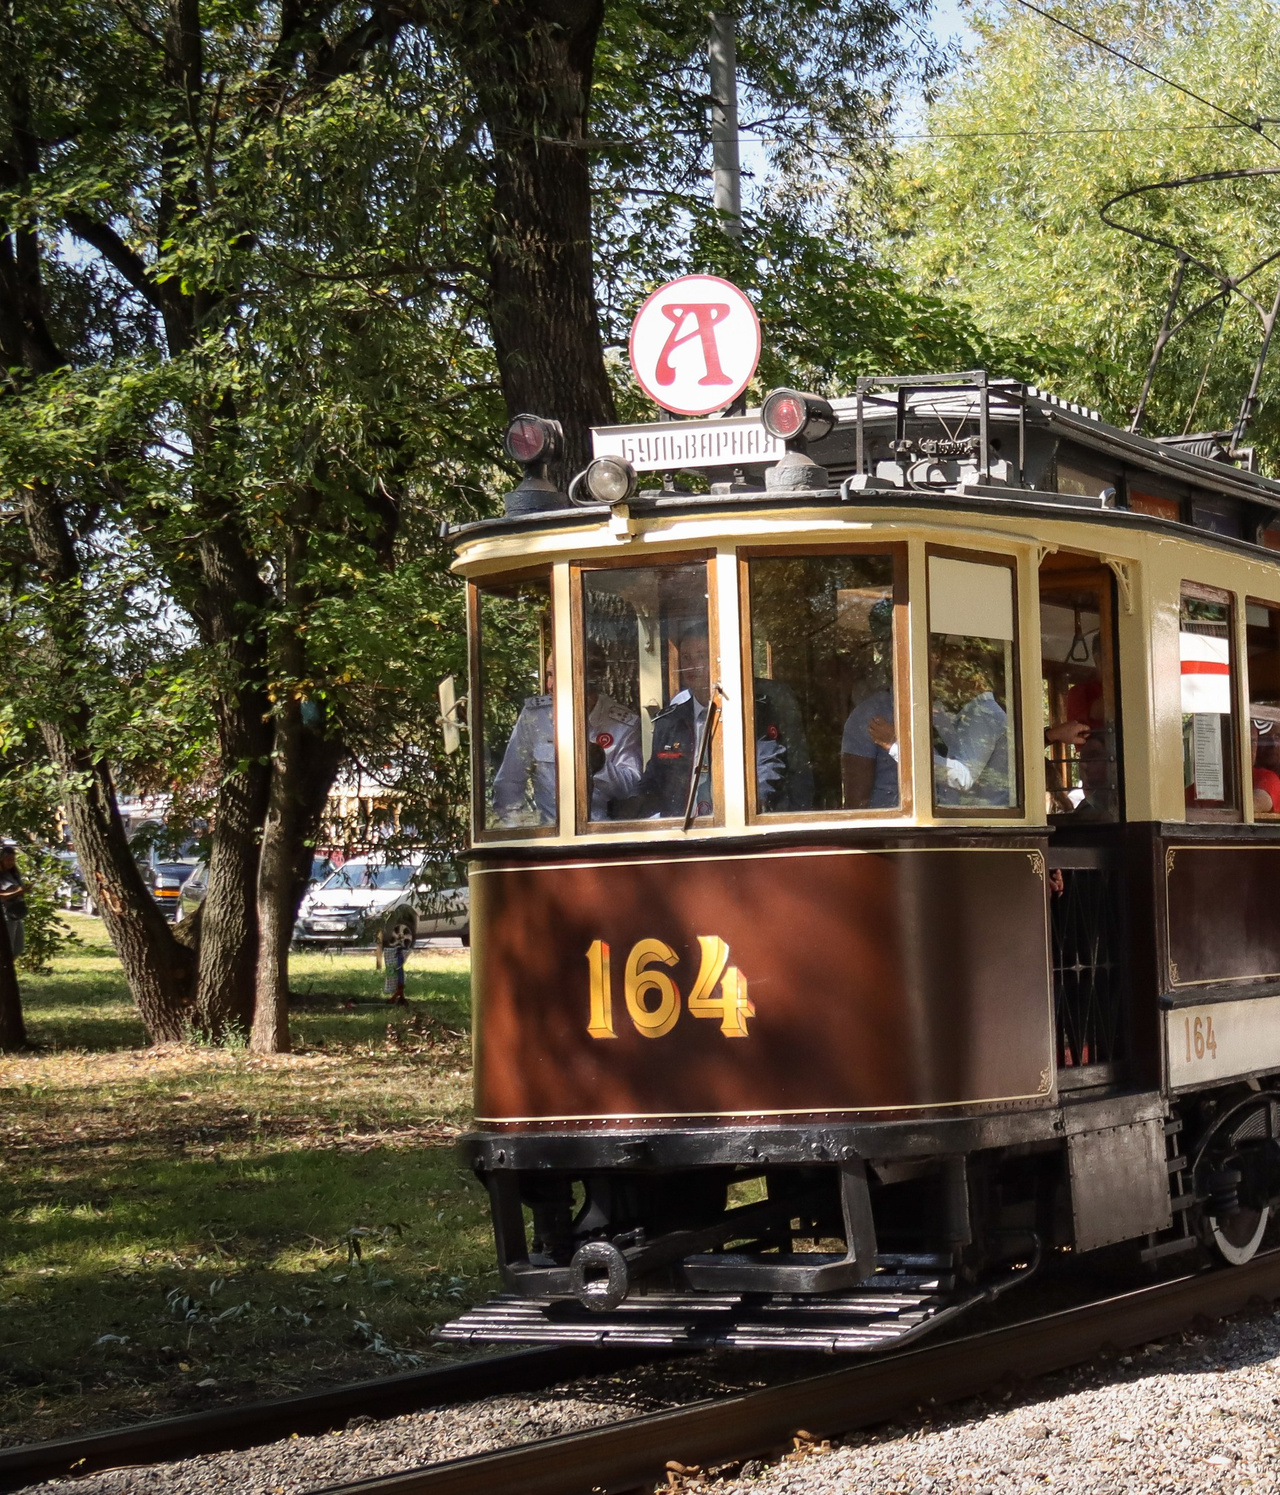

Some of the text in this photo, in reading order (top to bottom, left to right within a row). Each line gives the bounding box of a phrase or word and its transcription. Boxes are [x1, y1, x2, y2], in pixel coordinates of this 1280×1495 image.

[621, 430, 777, 464] БУЛЬВАРНАЯ
[585, 935, 756, 1039] 164
[1184, 1016, 1218, 1063] 164
